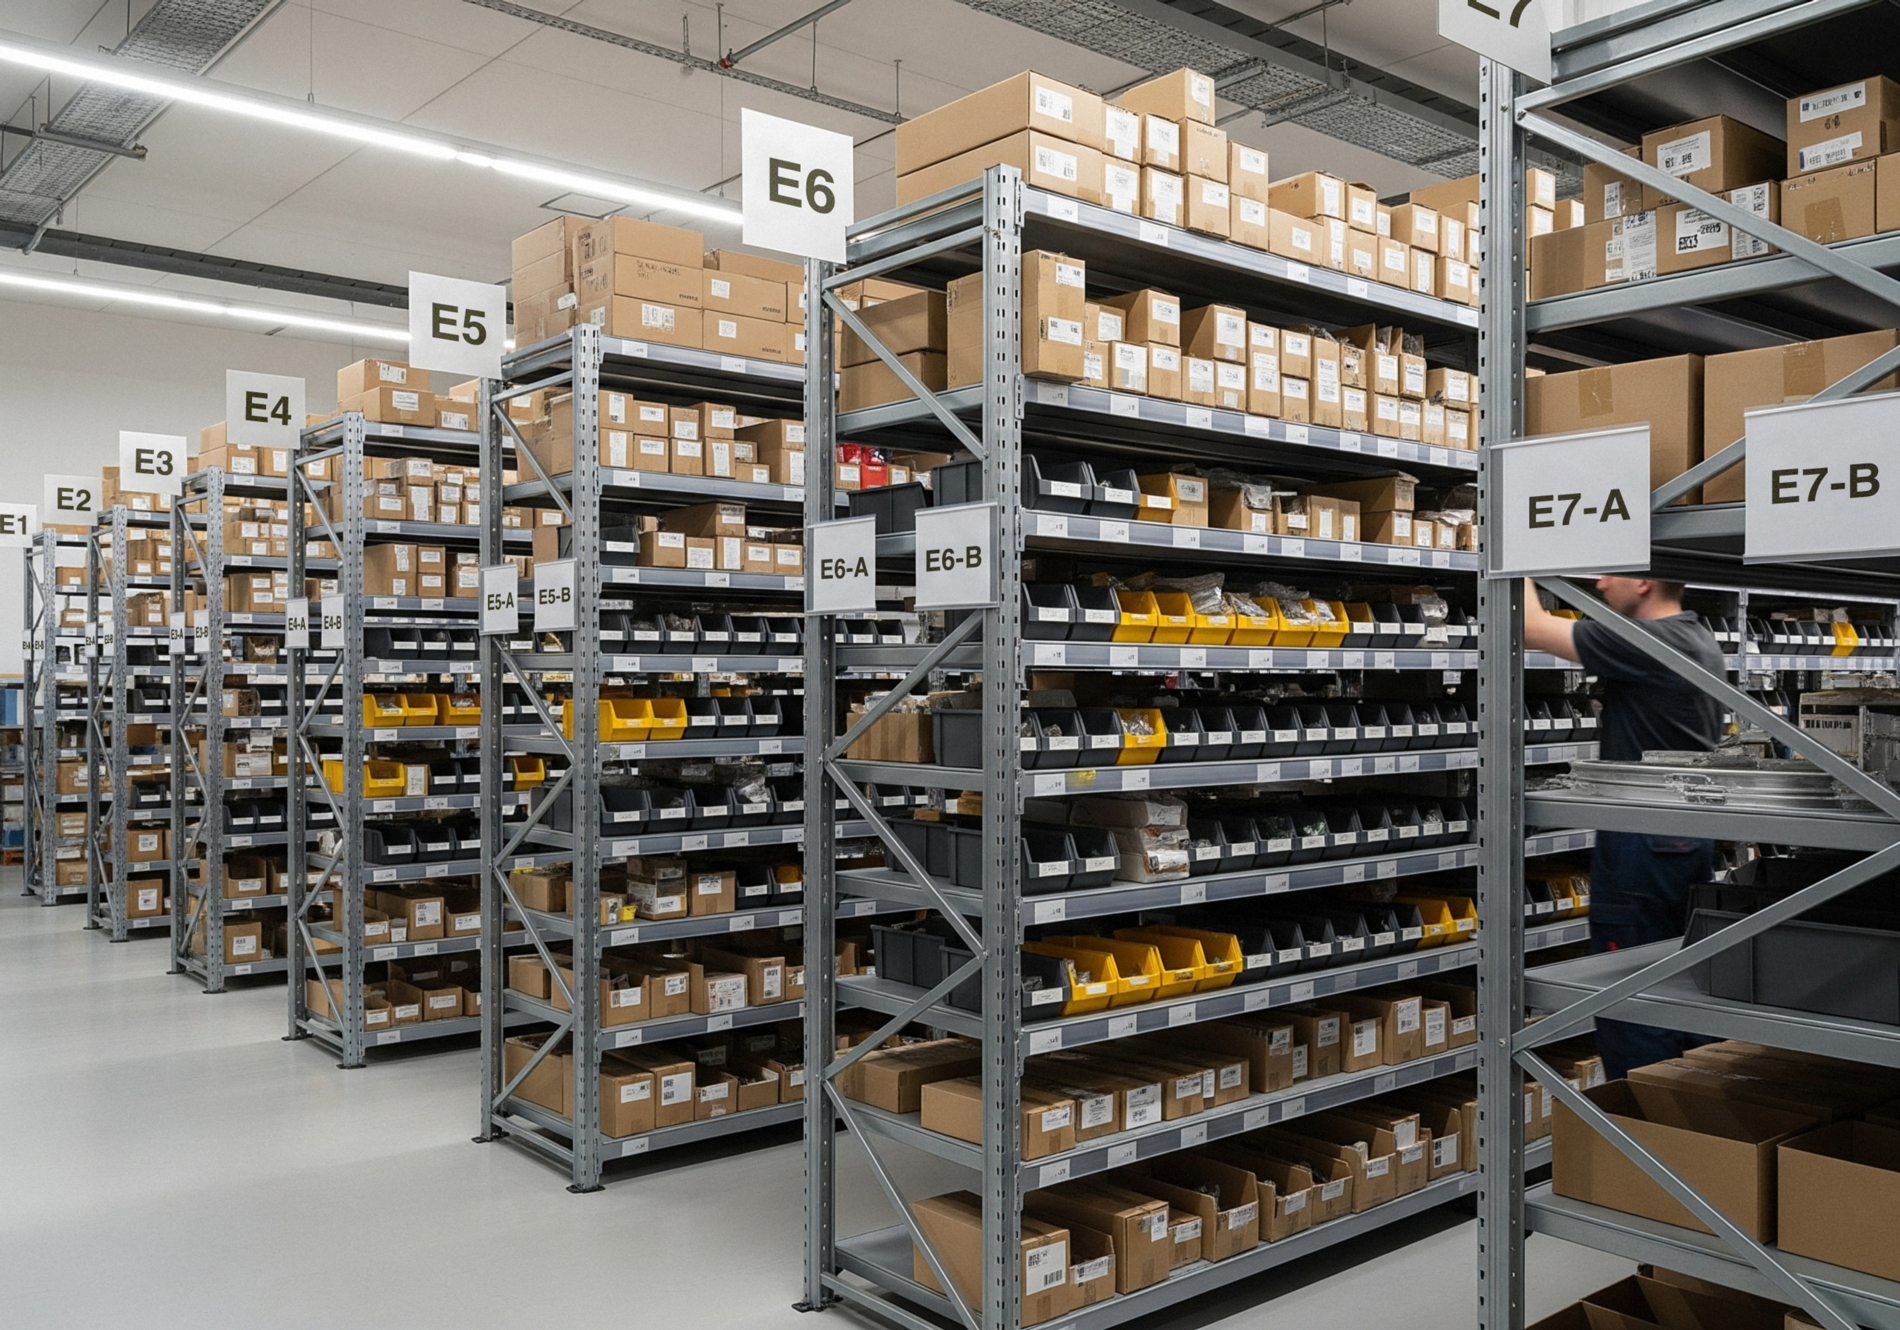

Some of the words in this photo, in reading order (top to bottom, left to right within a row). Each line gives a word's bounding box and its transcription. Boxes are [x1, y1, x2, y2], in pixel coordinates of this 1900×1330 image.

[770, 158, 835, 214] E6
[432, 303, 486, 345] E5
[246, 391, 291, 425] E4
[136, 449, 173, 475] E3
[1772, 463, 1879, 504] E7-B
[58, 488, 91, 511] E2
[1529, 489, 1630, 528] E7-A
[0, 514, 26, 534] E1
[821, 557, 868, 579] E6-A
[926, 546, 981, 572] E6-B
[488, 592, 514, 610] E5-A
[540, 587, 570, 604] E5-B
[195, 626, 209, 638] E3-B
[289, 617, 306, 630] E4-A
[324, 616, 341, 629] E4-B
[171, 629, 183, 640] E3-A
